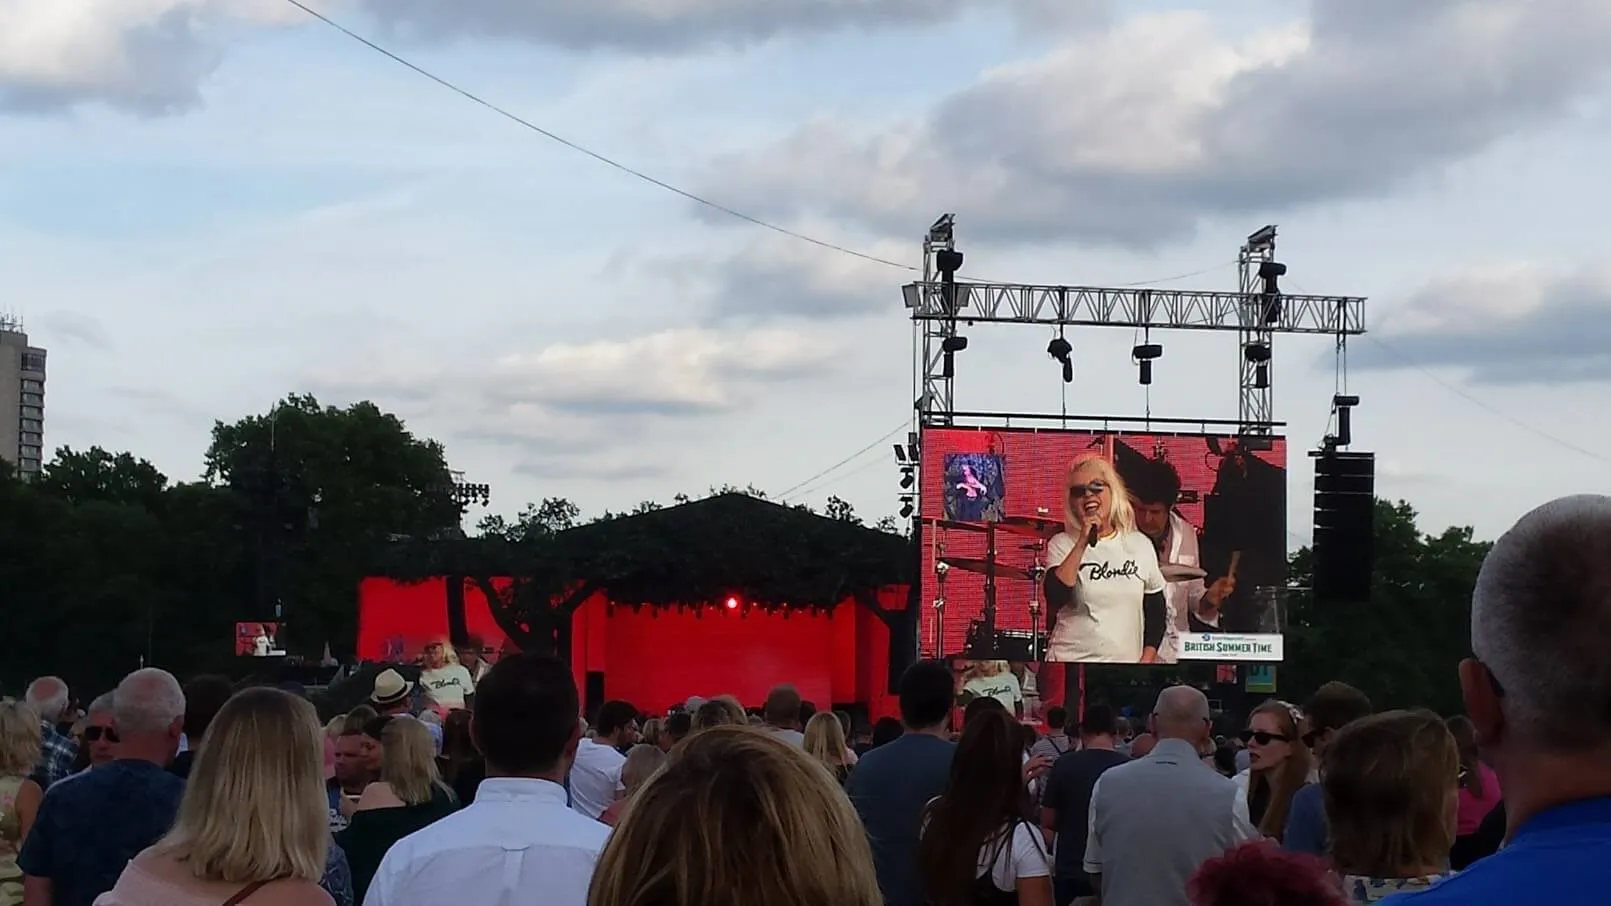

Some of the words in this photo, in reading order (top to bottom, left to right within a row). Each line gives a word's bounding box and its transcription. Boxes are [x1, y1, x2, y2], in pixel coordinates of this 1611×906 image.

[1079, 560, 1141, 580] Blondie
[1184, 641, 1215, 652] BRITISH
[1216, 642, 1251, 653] SUMMER
[1252, 643, 1273, 654] TIME
